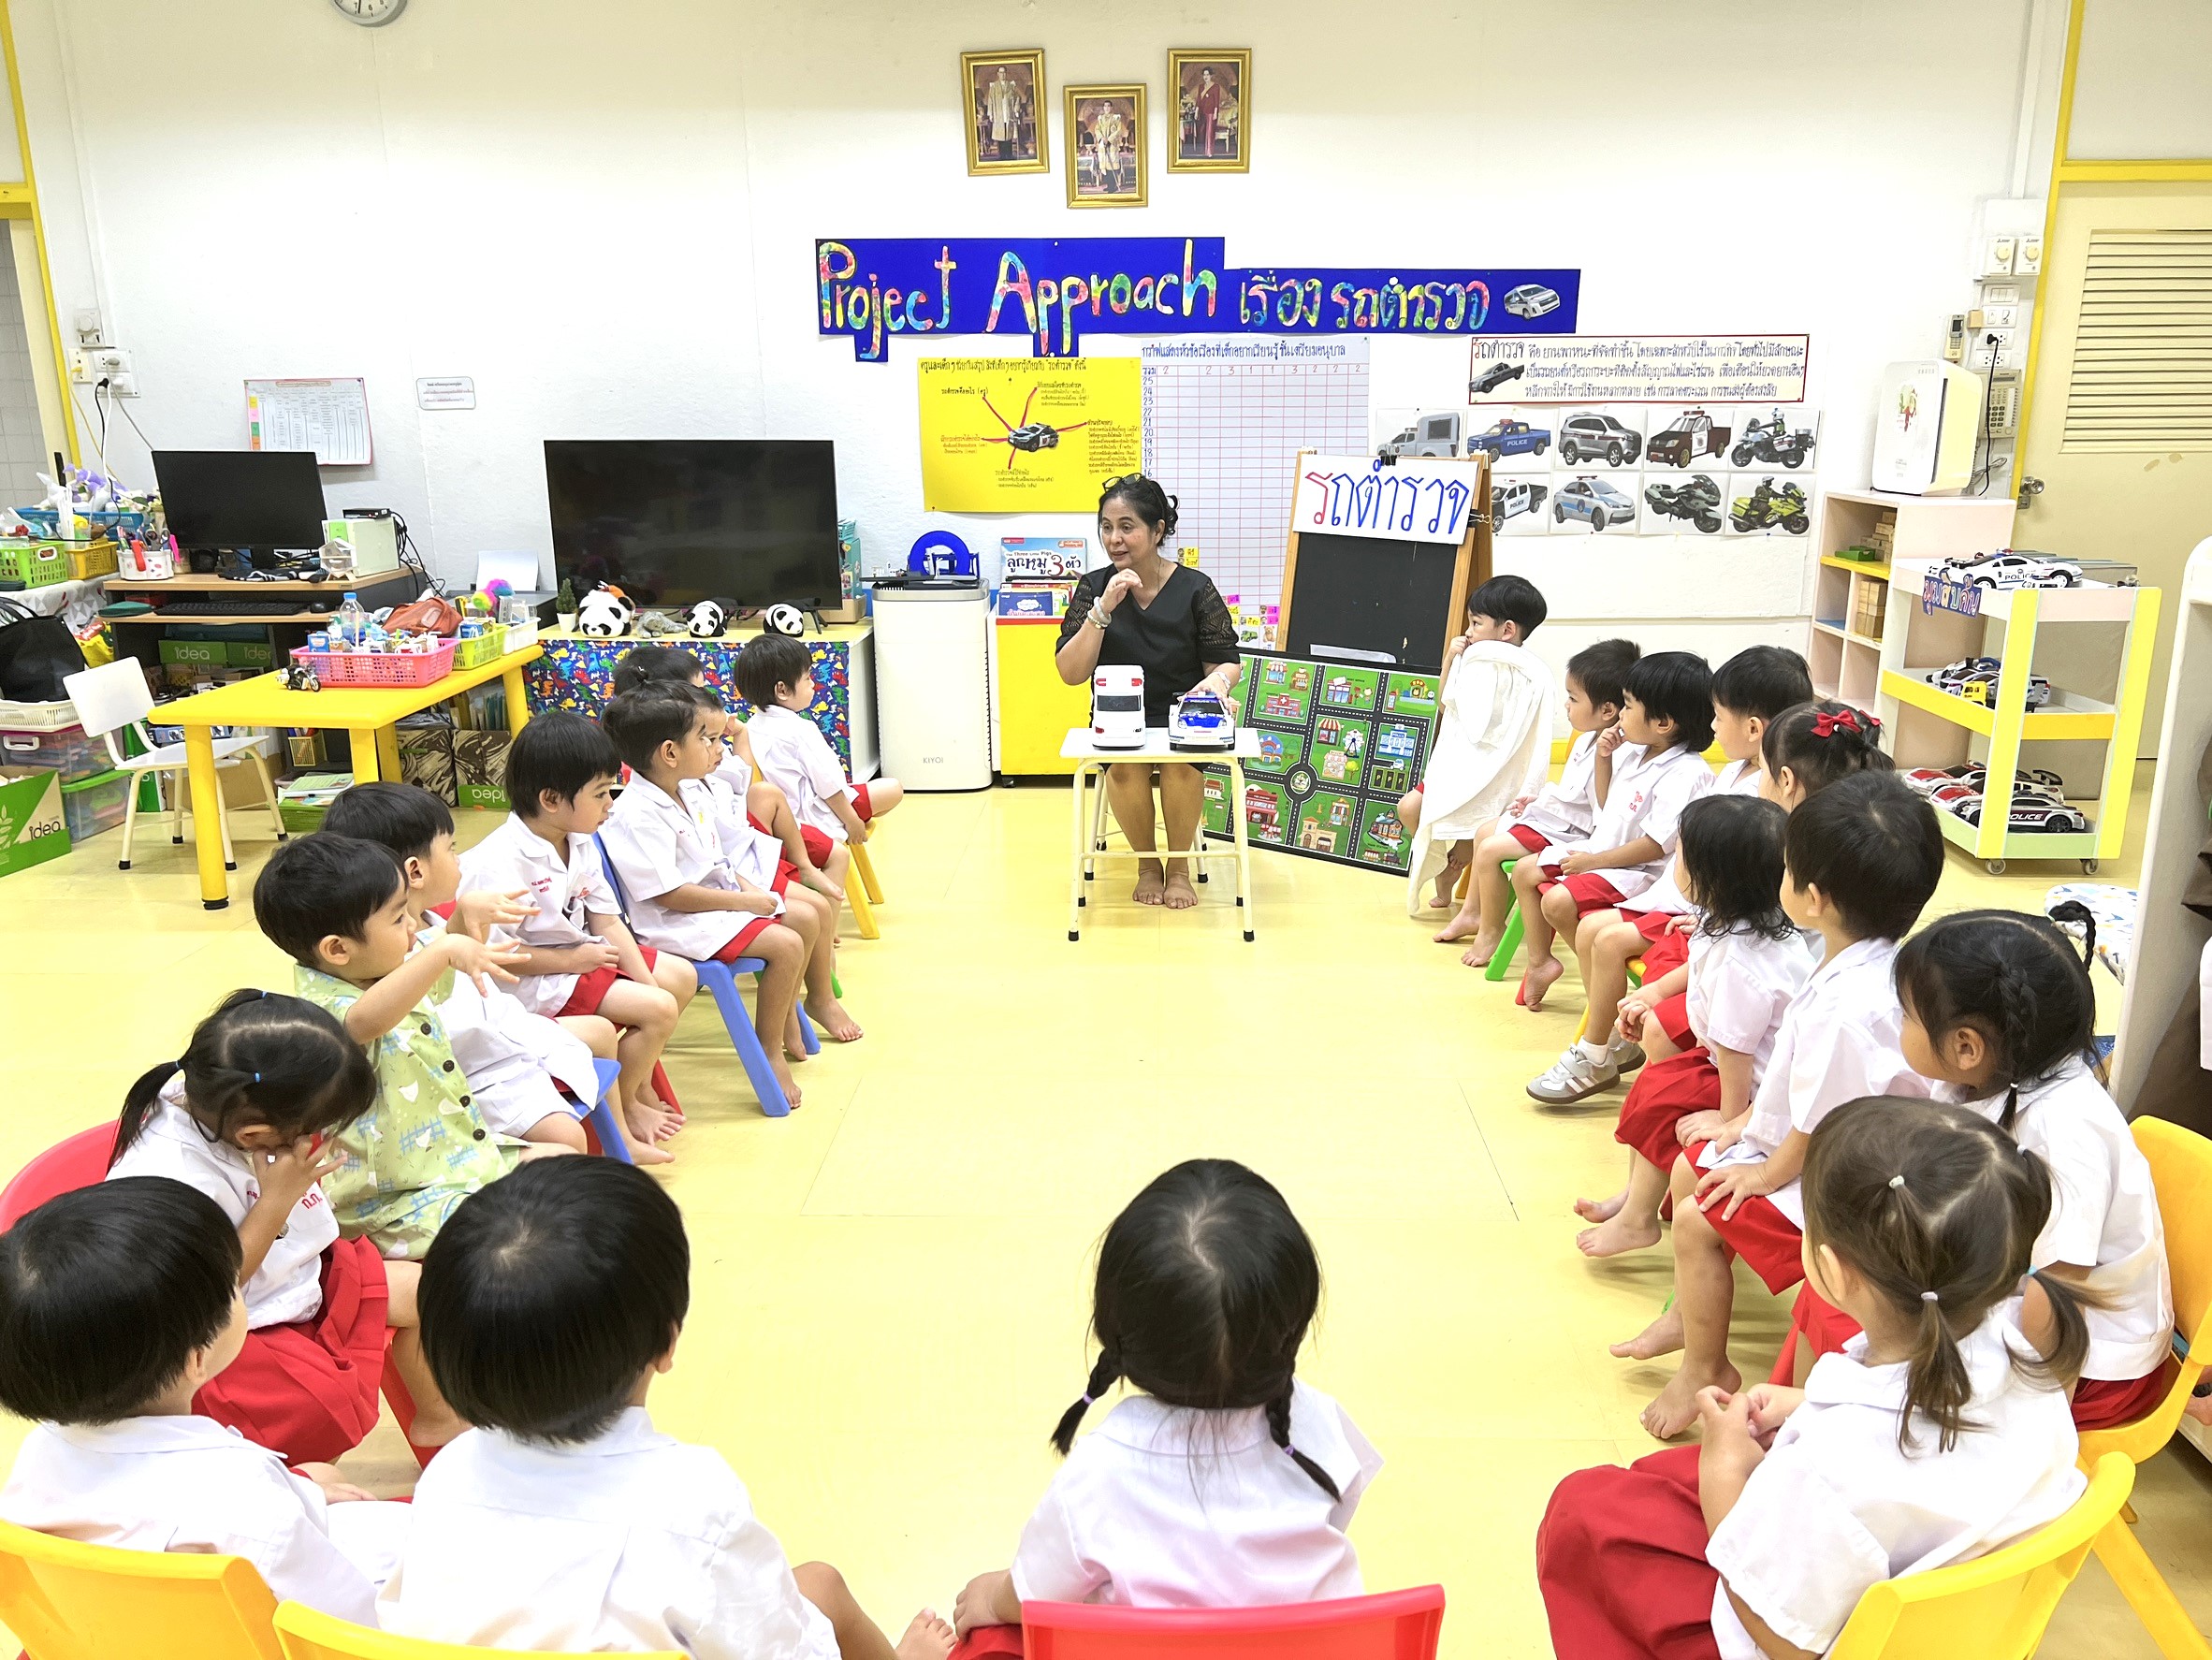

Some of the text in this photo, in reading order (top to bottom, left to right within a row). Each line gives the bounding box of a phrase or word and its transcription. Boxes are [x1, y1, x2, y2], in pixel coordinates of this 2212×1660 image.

[818, 238, 1217, 359] Project Approach
[1240, 270, 1491, 330] เรื่อง รถตำรวจ
[1473, 339, 1525, 359] รถตำรวจ
[1164, 366, 1169, 375] 2
[1206, 366, 1212, 375] 2
[1228, 366, 1235, 375] 3
[1291, 365, 1298, 373] 3
[1313, 365, 1317, 373] 2
[1333, 365, 1339, 373] 2
[1355, 365, 1361, 373] 2
[1143, 376, 1153, 386] 25
[1143, 387, 1153, 396] 24
[1143, 397, 1153, 406] 23
[1143, 408, 1153, 416] 22
[1143, 417, 1151, 427] 21
[1143, 428, 1153, 437] 20
[1144, 438, 1153, 447] 19
[1506, 439, 1528, 447] POLICE
[1144, 448, 1153, 458] 18
[1144, 459, 1153, 468] 17
[1144, 469, 1153, 477] 16
[1305, 459, 1469, 534] รถตำรวจ
[1510, 499, 1524, 509] POLICE
[1007, 554, 1082, 576] ลูกหมู 3 ตัว
[174, 646, 211, 661] idea
[472, 789, 506, 803] idea
[29, 821, 61, 840] idea
